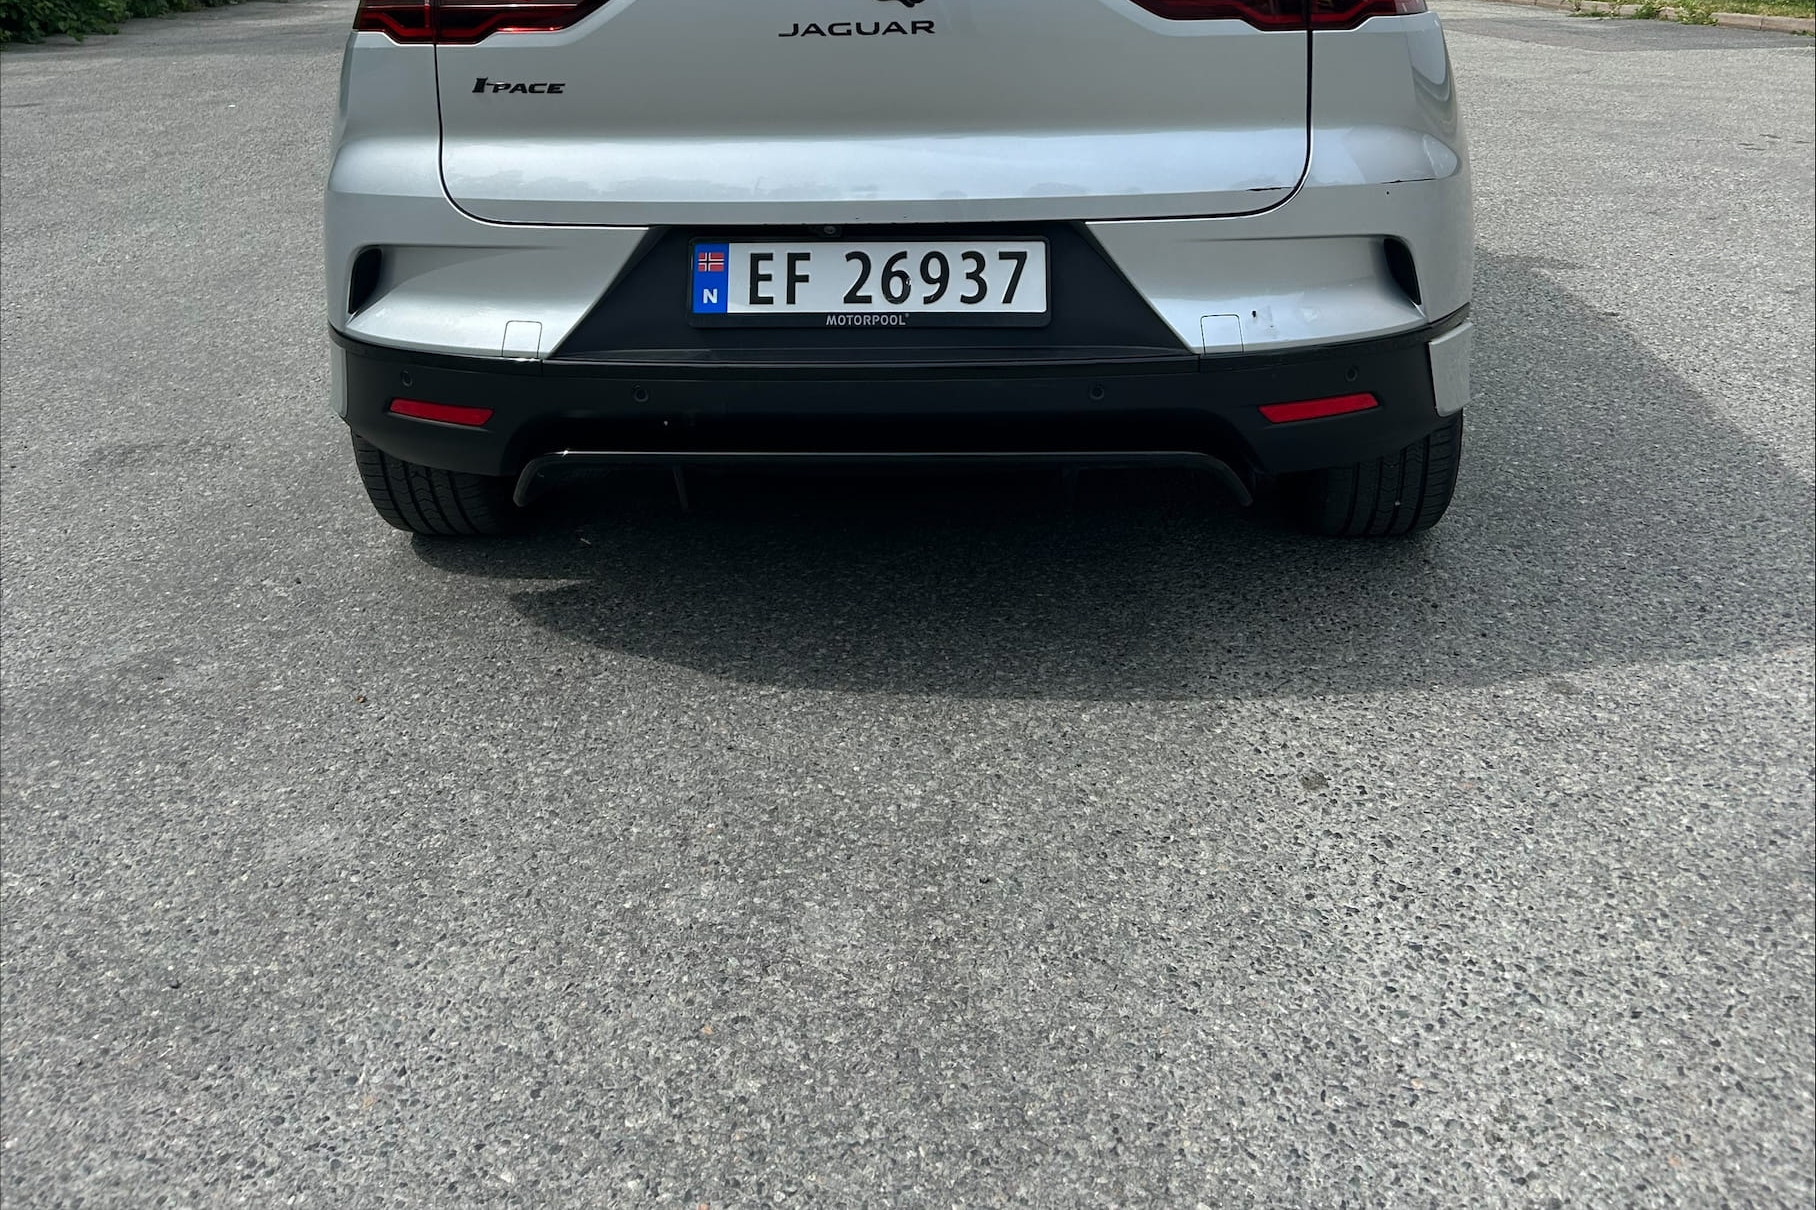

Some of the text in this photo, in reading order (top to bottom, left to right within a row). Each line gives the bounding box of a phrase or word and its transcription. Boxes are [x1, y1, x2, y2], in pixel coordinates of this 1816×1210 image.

[778, 20, 935, 37] JAGUAR
[749, 251, 1028, 305] EF 26937
[702, 288, 718, 304] N
